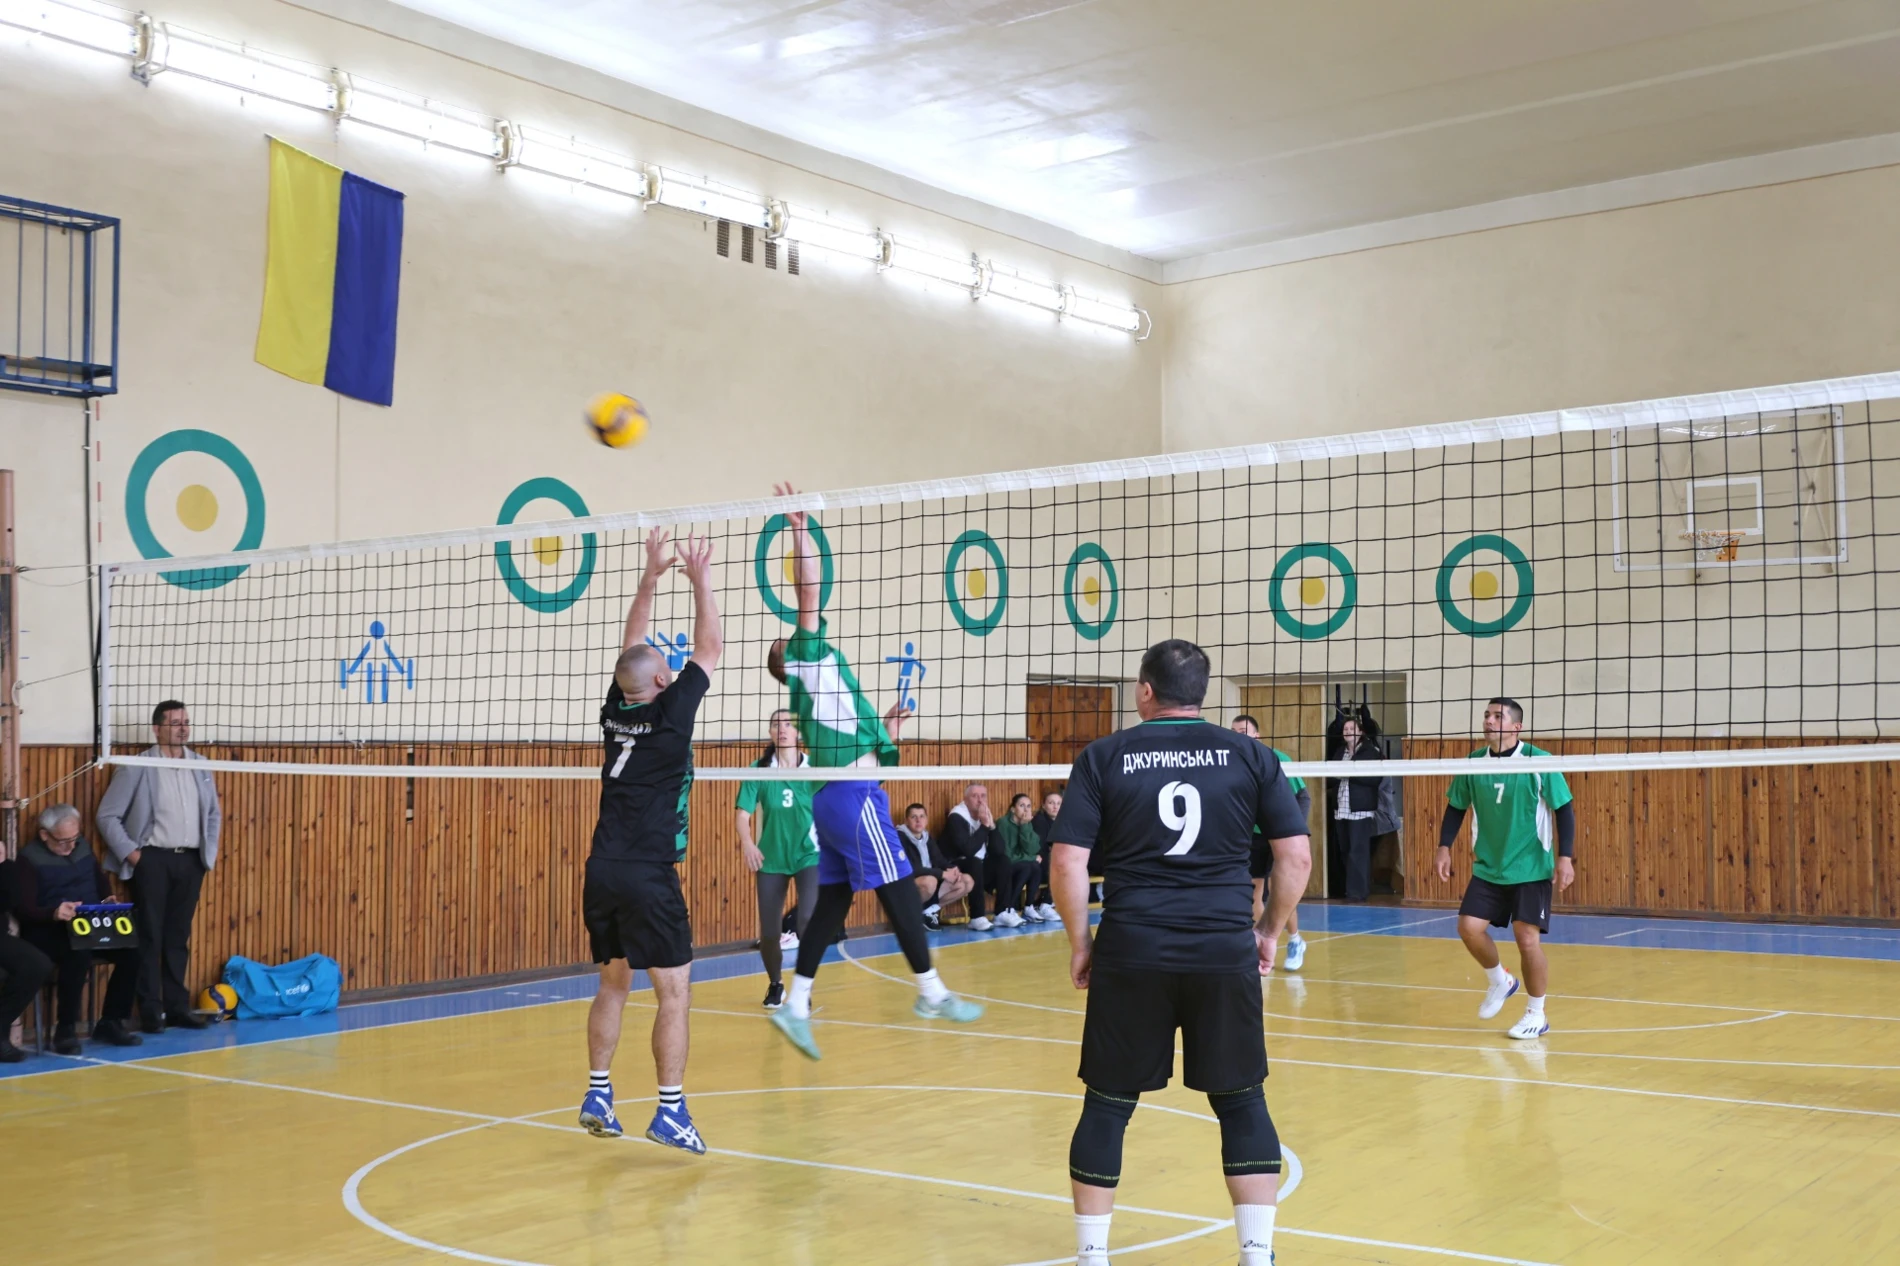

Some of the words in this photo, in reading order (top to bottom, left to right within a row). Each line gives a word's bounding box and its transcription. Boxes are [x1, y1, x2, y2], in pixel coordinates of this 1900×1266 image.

[609, 733, 636, 778] 7
[1123, 750, 1215, 775] ДЖУРИНСЬКА
[1215, 749, 1230, 766] ТГ
[782, 788, 794, 808] 3
[1493, 783, 1505, 804] 7
[1158, 780, 1202, 856] 9
